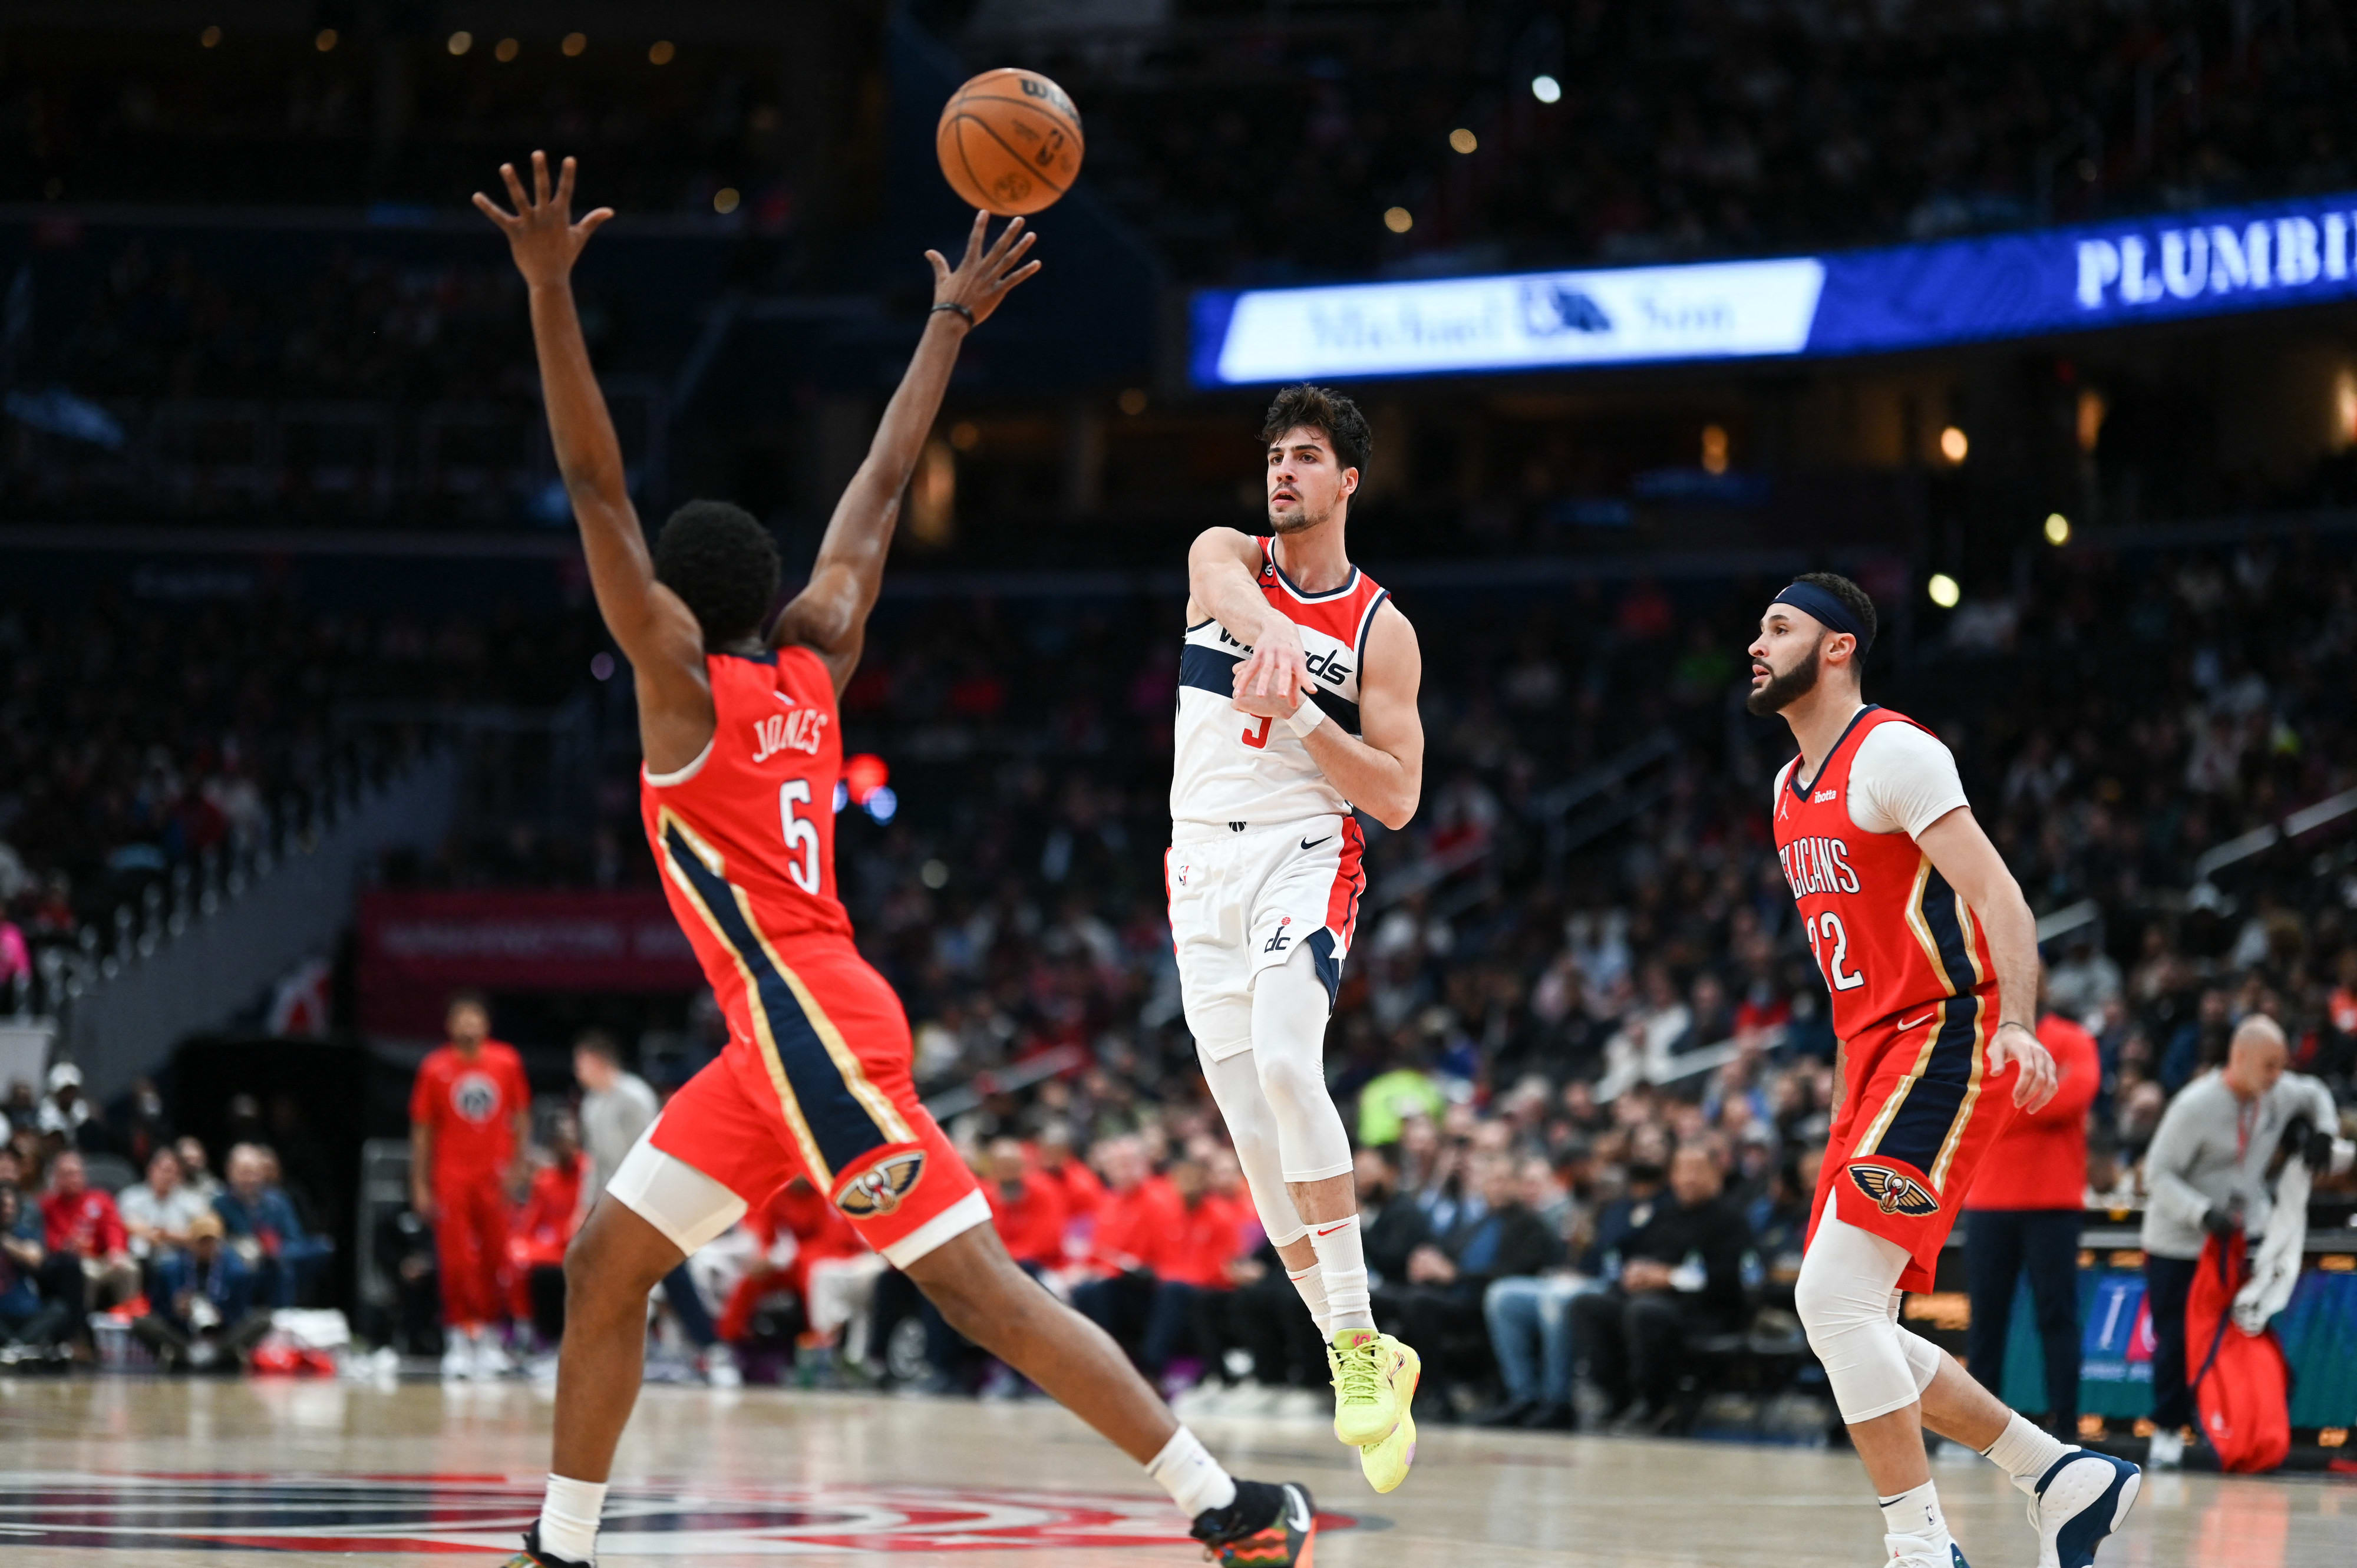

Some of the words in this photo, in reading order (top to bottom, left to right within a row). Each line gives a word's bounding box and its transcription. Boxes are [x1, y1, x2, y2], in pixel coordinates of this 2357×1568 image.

[2076, 210, 2357, 309] PLUMBI
[752, 709, 828, 762] JONES
[1814, 789, 1837, 804] ibotta
[780, 778, 820, 896] 5
[1264, 925, 1291, 953] dc
